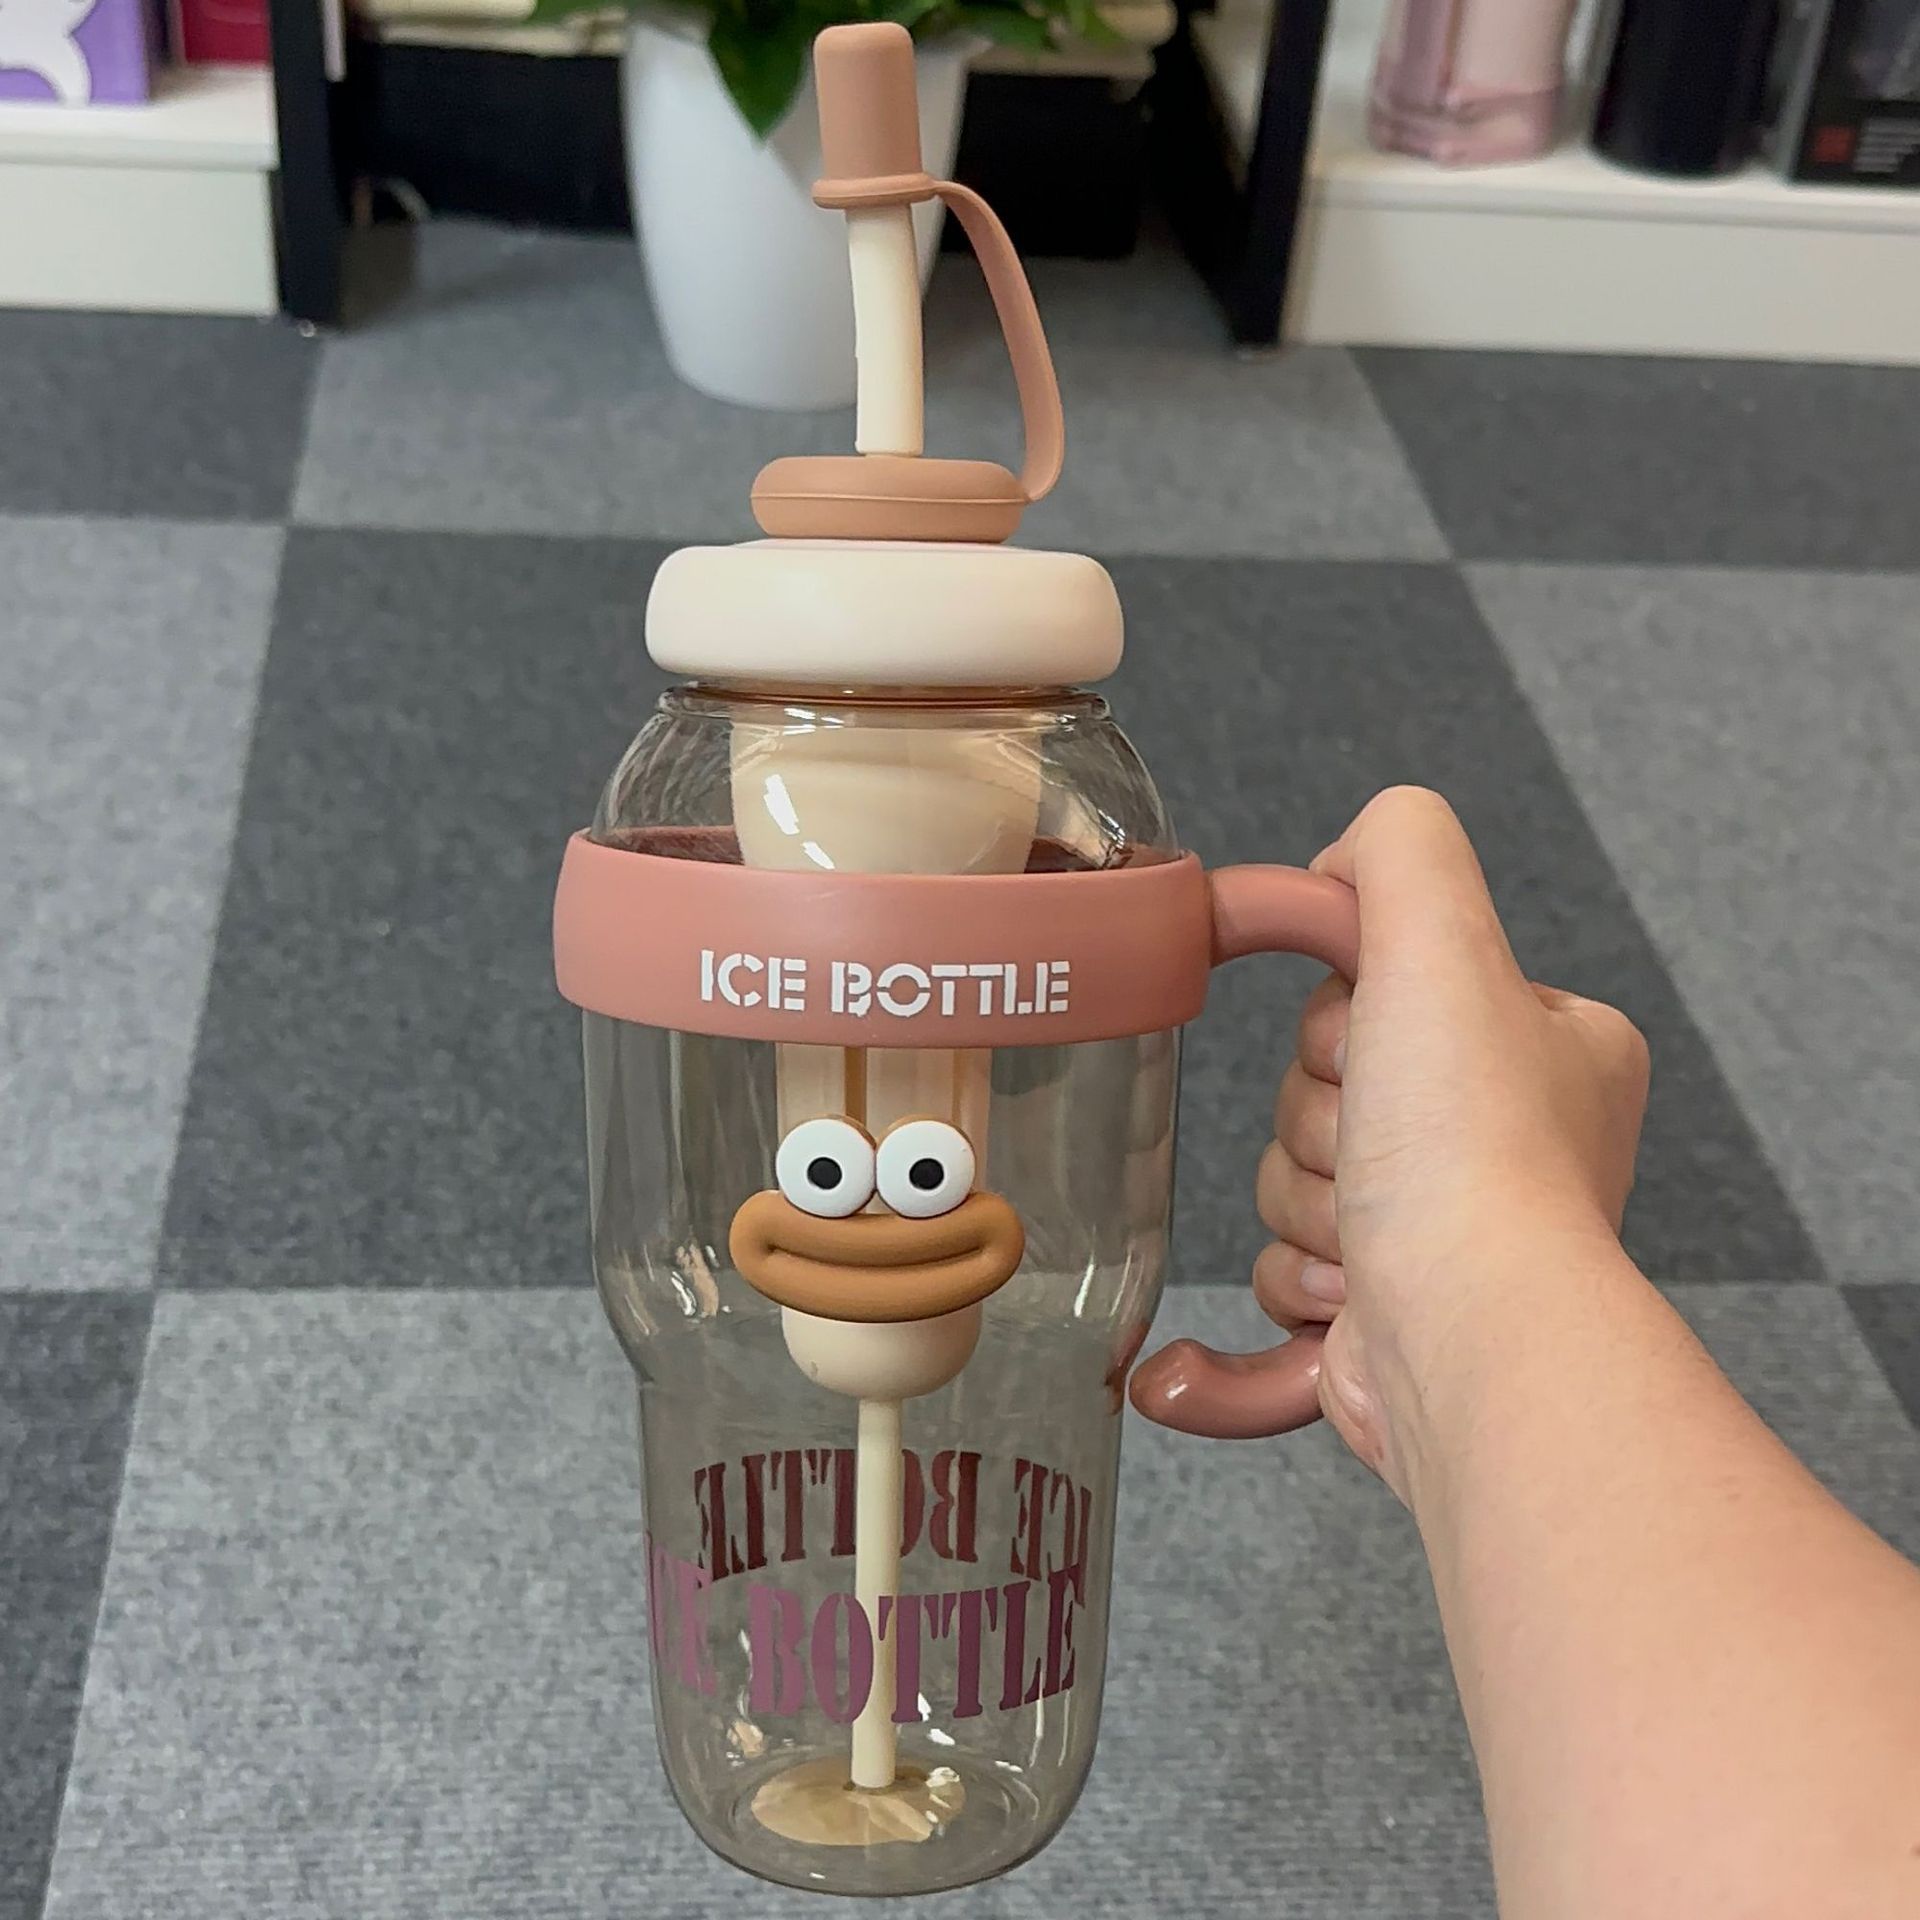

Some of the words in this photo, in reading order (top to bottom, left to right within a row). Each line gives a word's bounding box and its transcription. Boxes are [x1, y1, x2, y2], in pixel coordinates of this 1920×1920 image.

[700, 949, 807, 1012] ICE
[830, 960, 1070, 1017] BOTTLE
[746, 1563, 1079, 1724] BOTTLE
